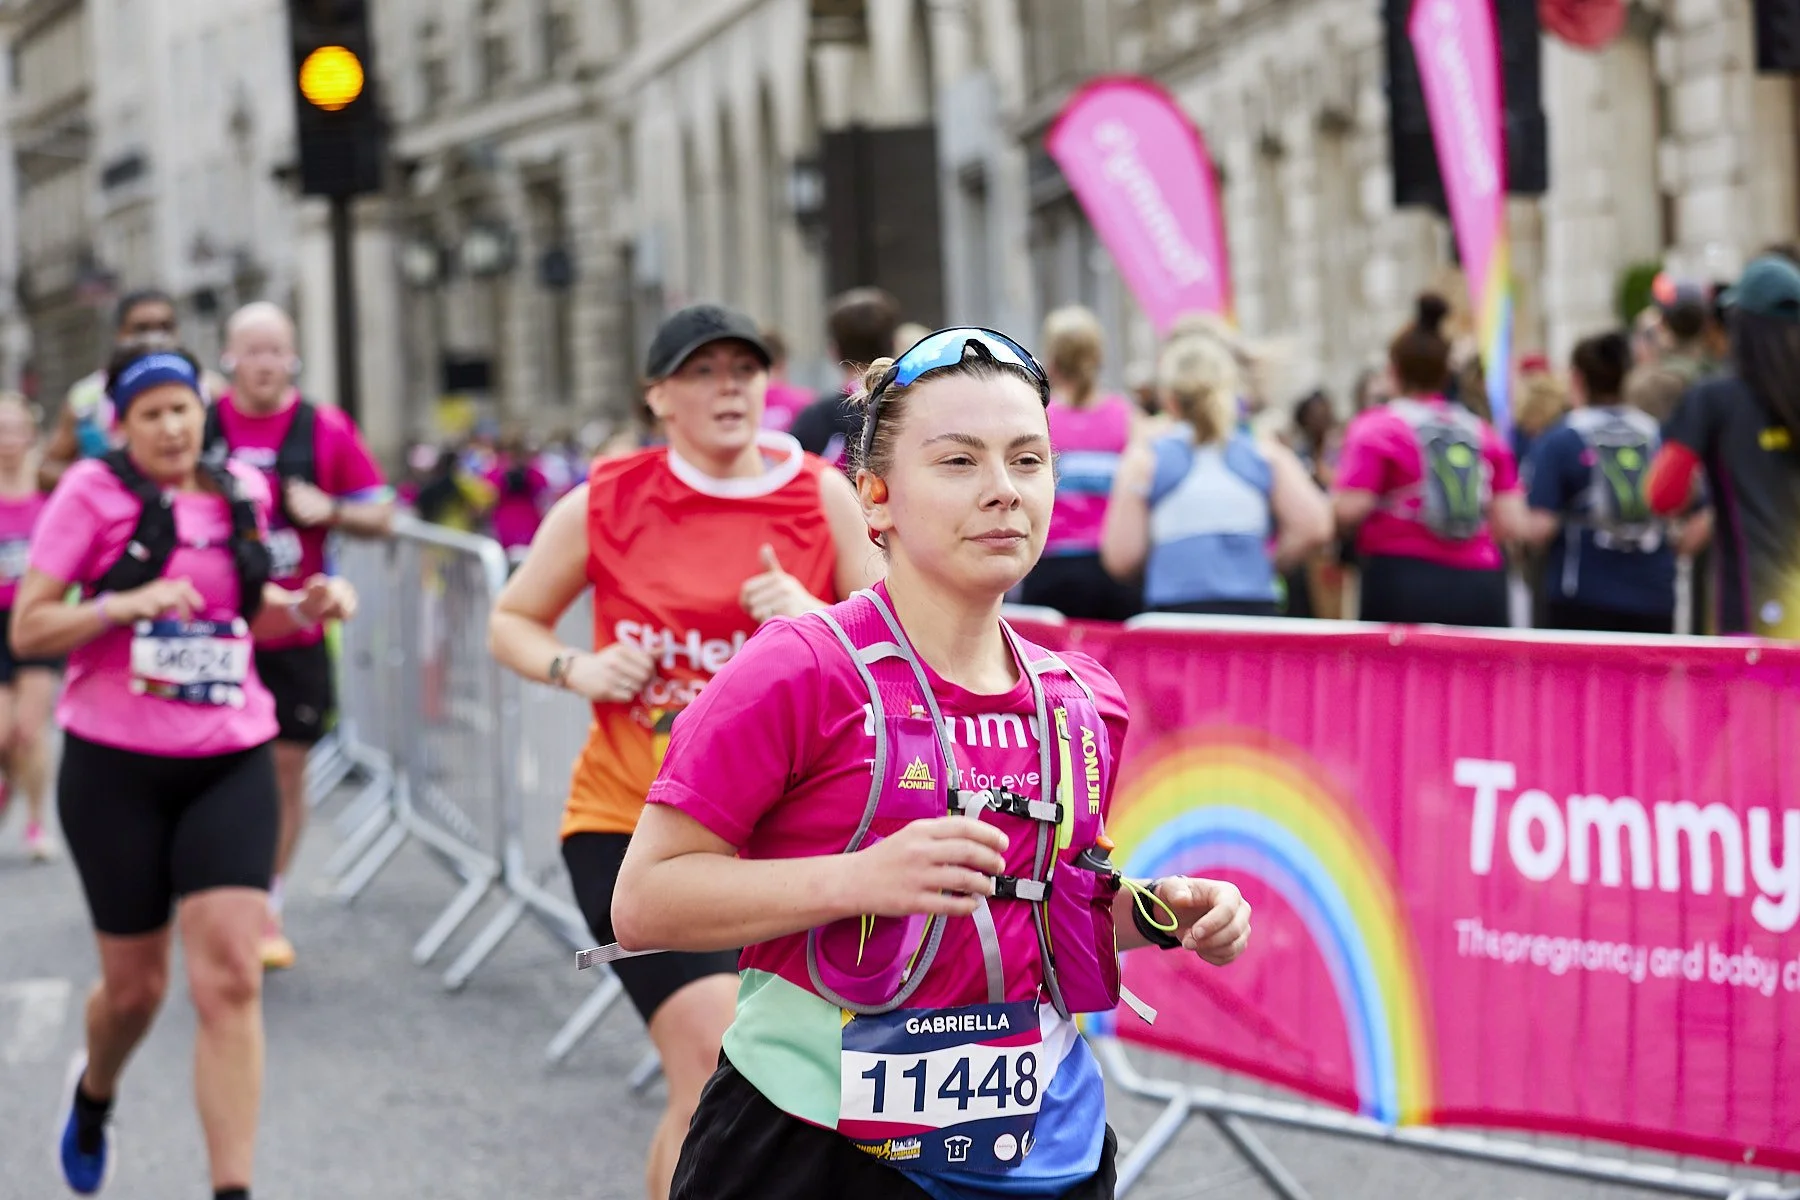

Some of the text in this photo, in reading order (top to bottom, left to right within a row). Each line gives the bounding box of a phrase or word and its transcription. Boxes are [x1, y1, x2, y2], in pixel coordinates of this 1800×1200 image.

[660, 628, 748, 674] Hel
[898, 780, 935, 790] AONIJIE
[970, 766, 996, 789] for
[1001, 771, 1040, 790] eve
[1079, 725, 1100, 815] AONIJIE
[1501, 931, 1648, 984] pregnancy
[1650, 938, 1705, 982] and
[1708, 941, 1779, 997] baby
[905, 1012, 1010, 1035] GABRIELLA
[861, 1051, 1038, 1114] 11448
[954, 1144, 960, 1156] S
